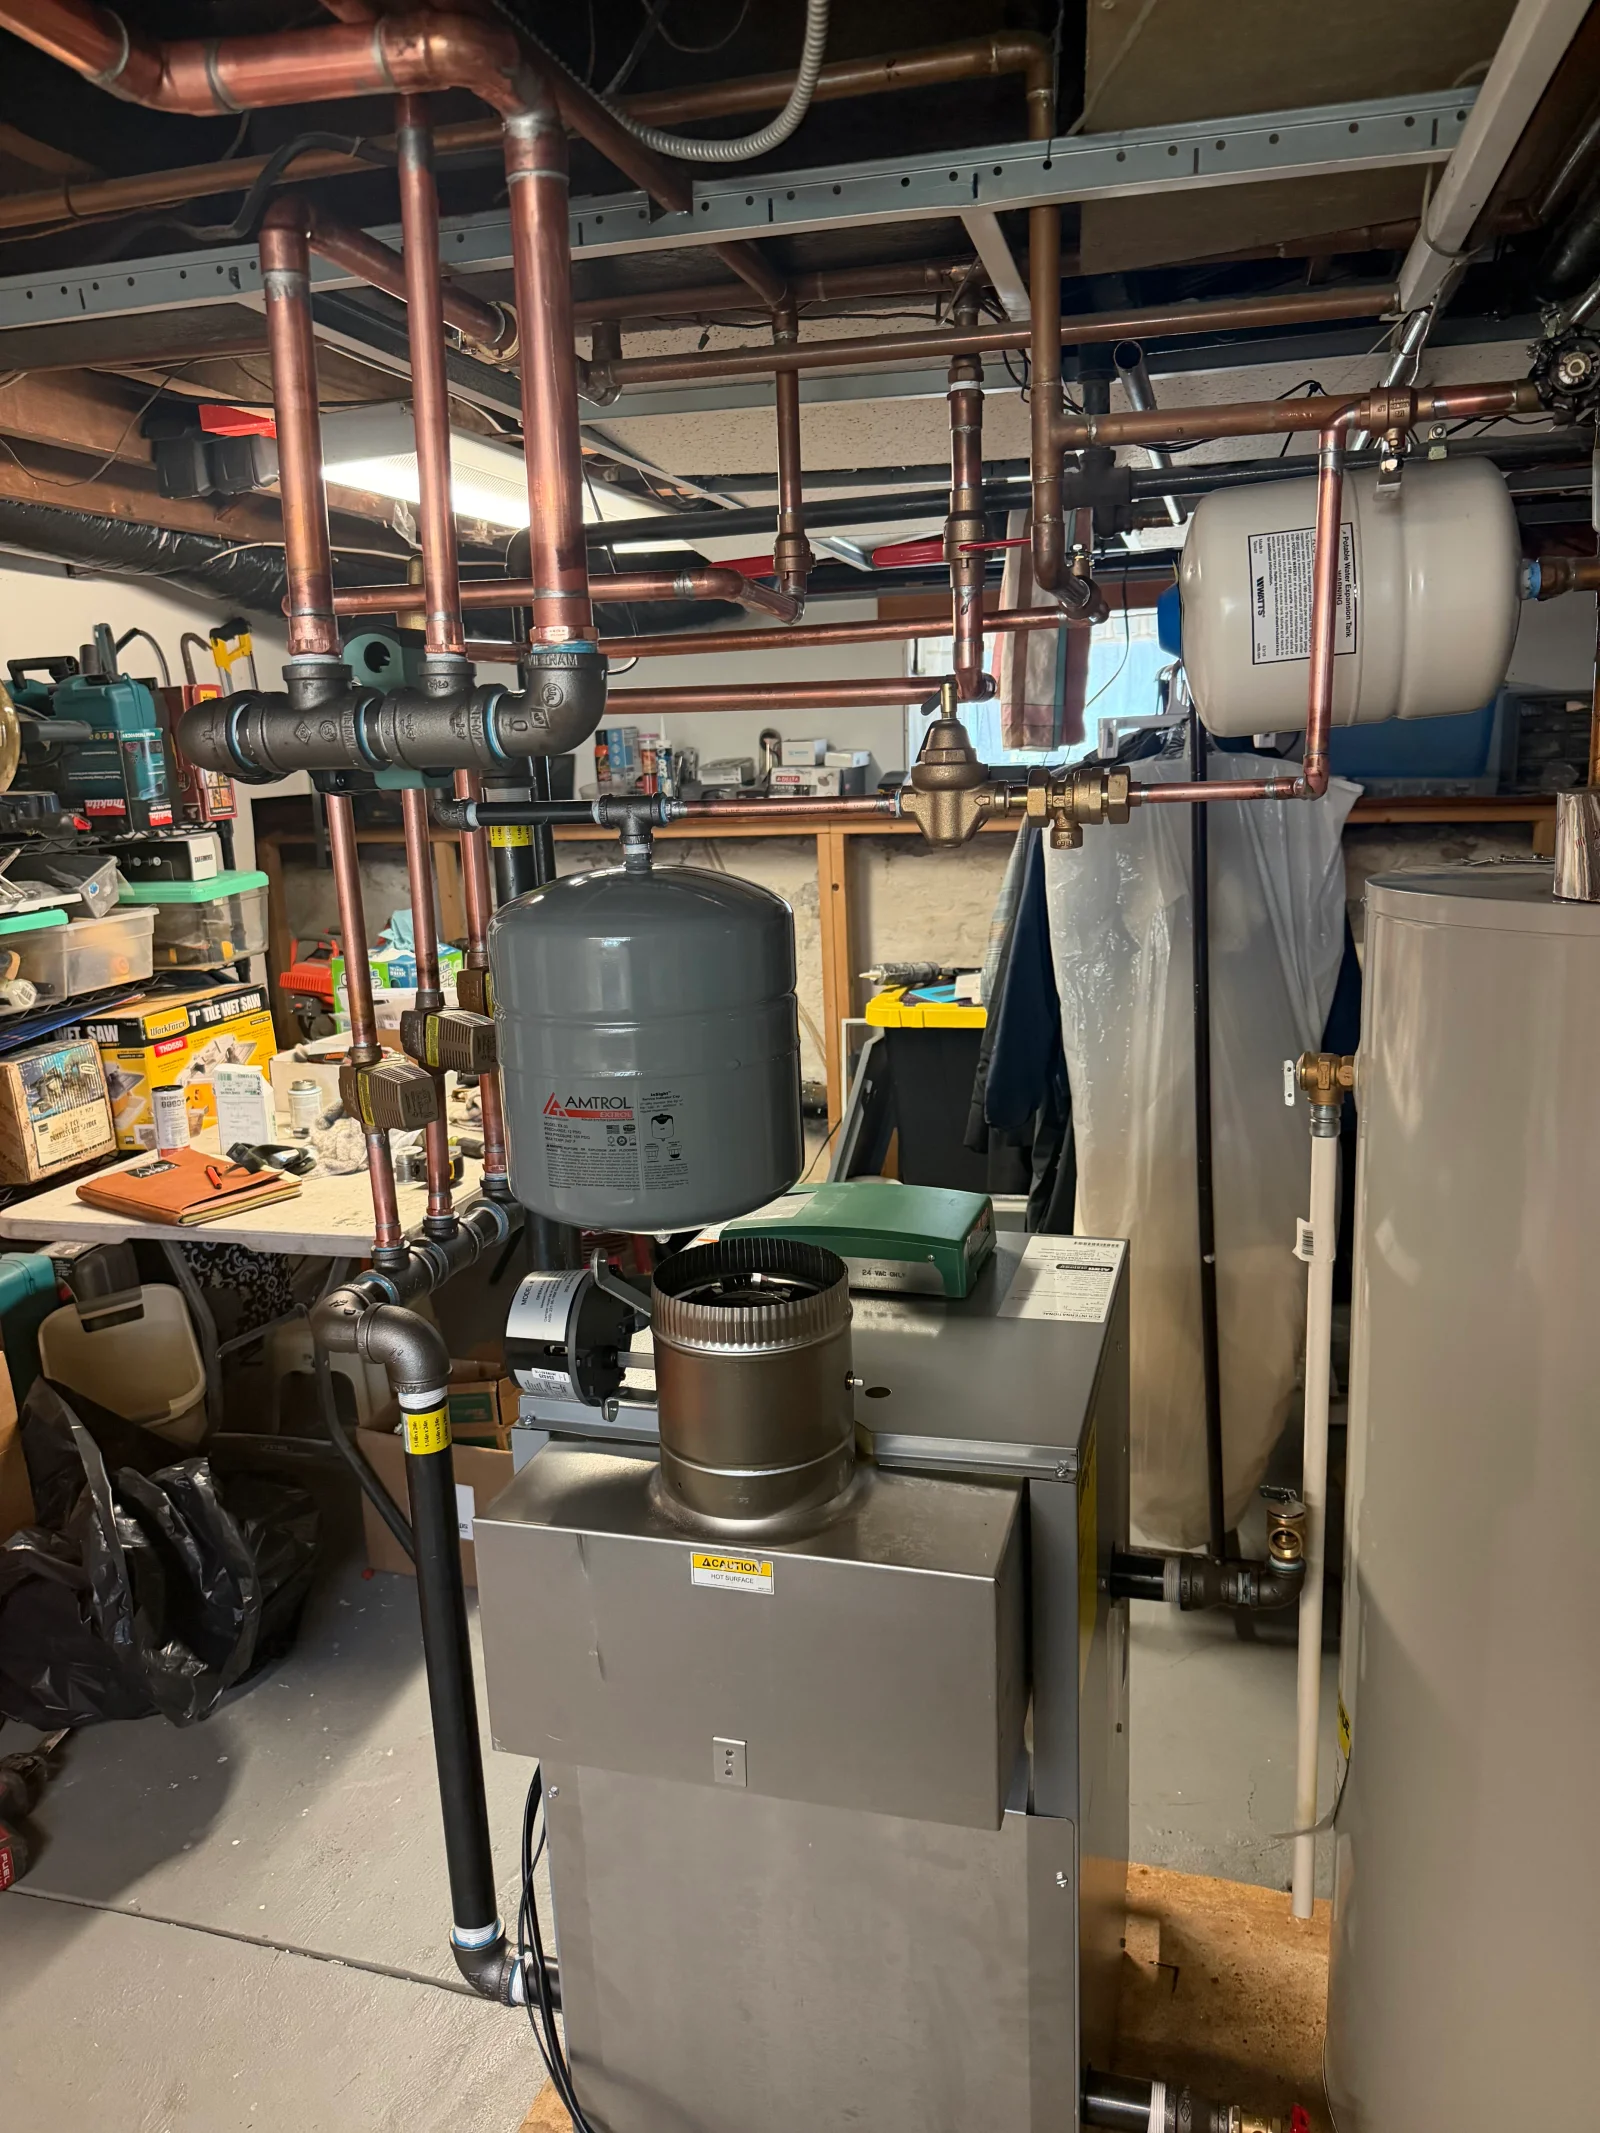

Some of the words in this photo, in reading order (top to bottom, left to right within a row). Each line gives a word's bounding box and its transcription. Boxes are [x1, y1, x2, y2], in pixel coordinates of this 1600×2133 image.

[1342, 536, 1350, 561] Potable
[1257, 588, 1265, 616] WATTS
[1344, 584, 1352, 620] Expansion
[203, 1004, 222, 1022] TILE
[221, 998, 241, 1017] WET
[240, 993, 261, 1011] SAW
[87, 1025, 119, 1042] SAW
[150, 1020, 187, 1036] WorkForce
[159, 1039, 184, 1054] THD550
[565, 1096, 634, 1110] AMTROL
[862, 1268, 872, 1276] 24
[521, 1284, 533, 1306] MODEL
[711, 1559, 763, 1574] CAUTION
[725, 1574, 754, 1584] SURFACE
[1, 1852, 10, 1885] FUEL
